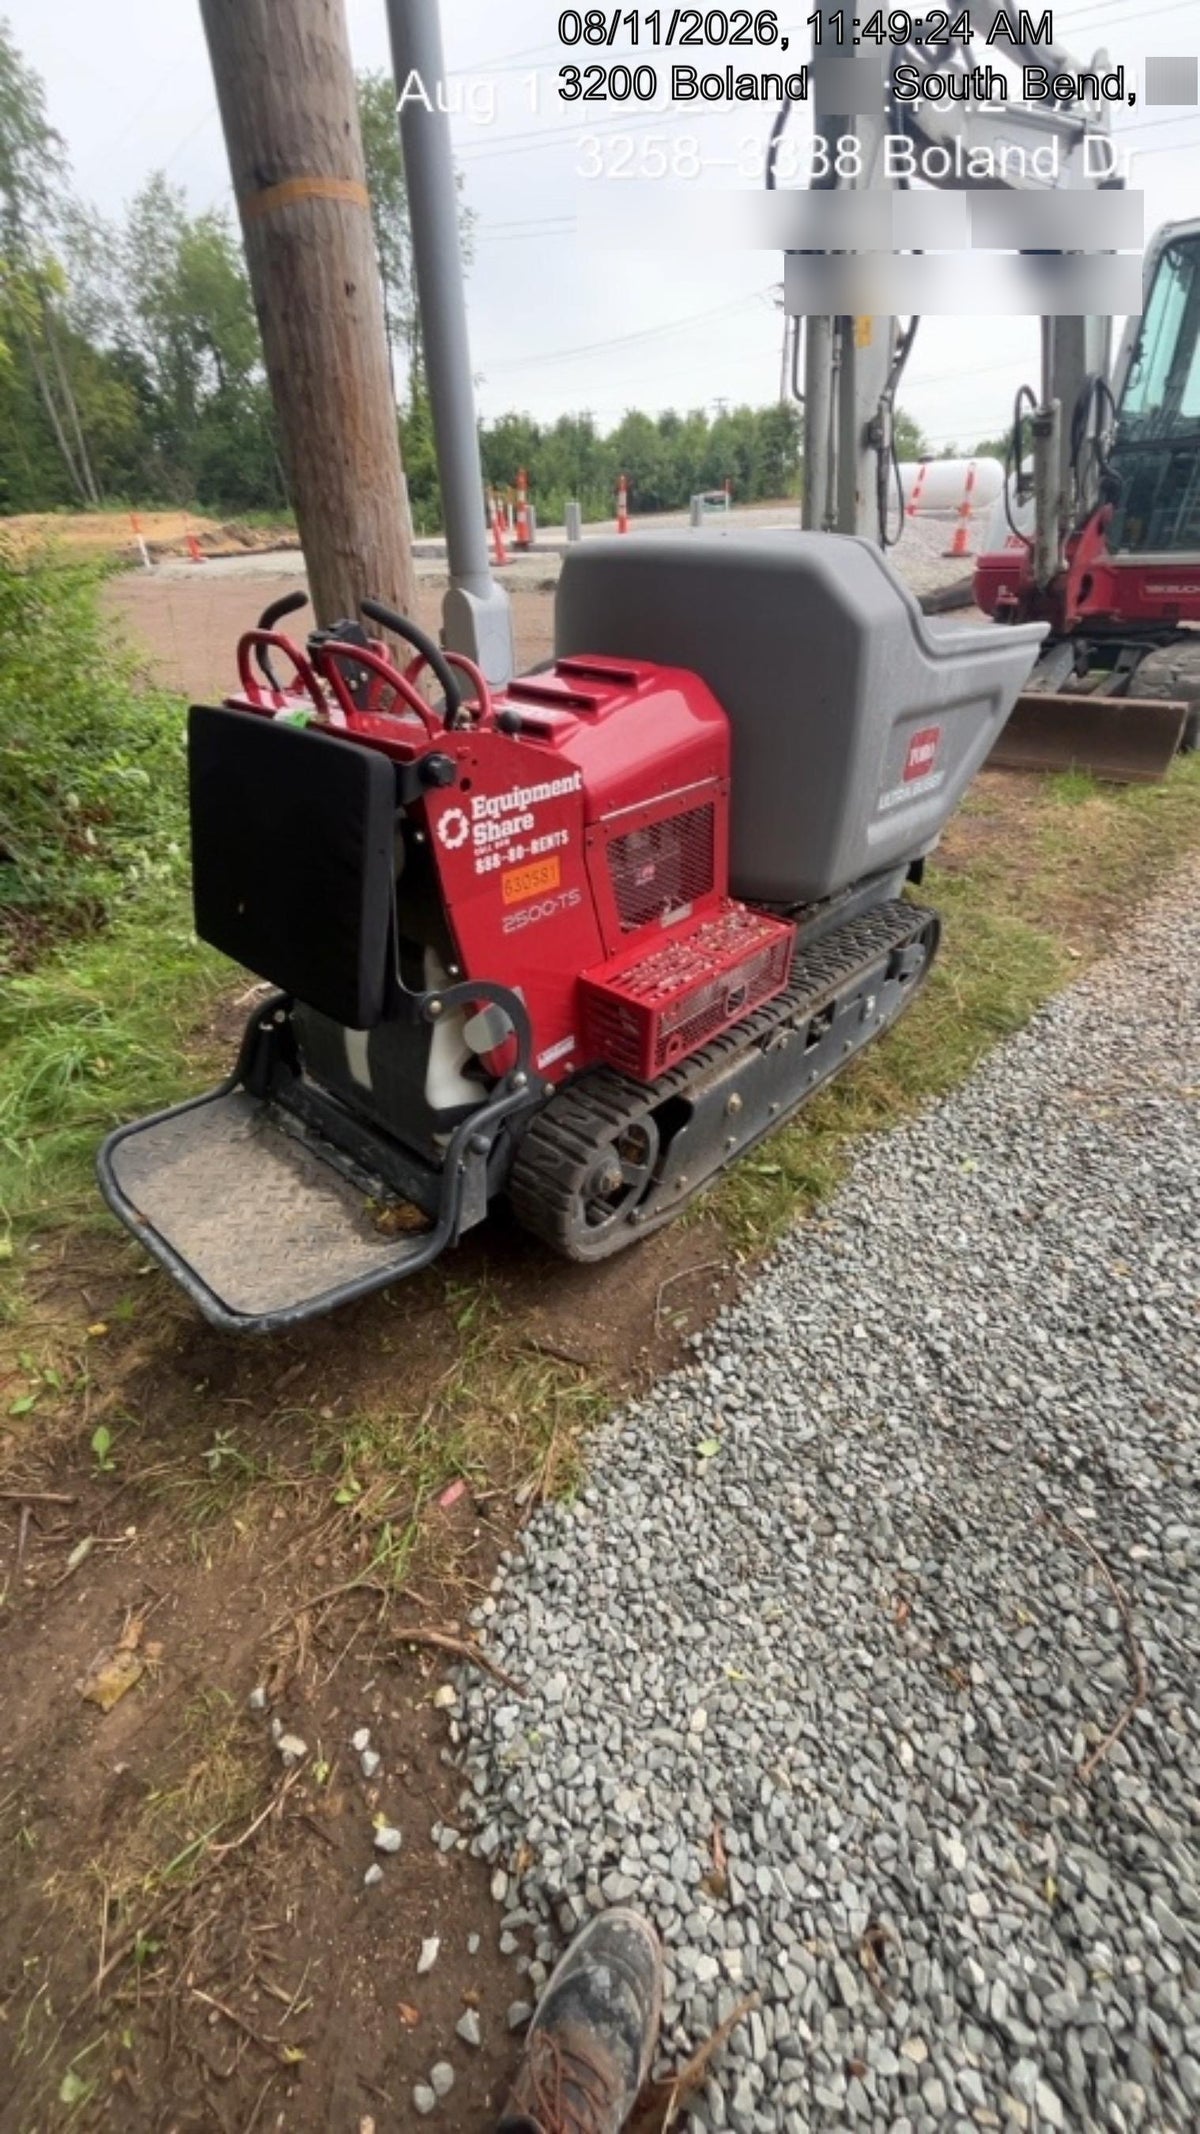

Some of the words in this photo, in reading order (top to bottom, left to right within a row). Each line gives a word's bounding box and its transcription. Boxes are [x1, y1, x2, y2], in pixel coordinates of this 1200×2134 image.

[471, 770, 582, 819] Equipment
[473, 813, 535, 846] Share
[504, 865, 557, 897] 630581
